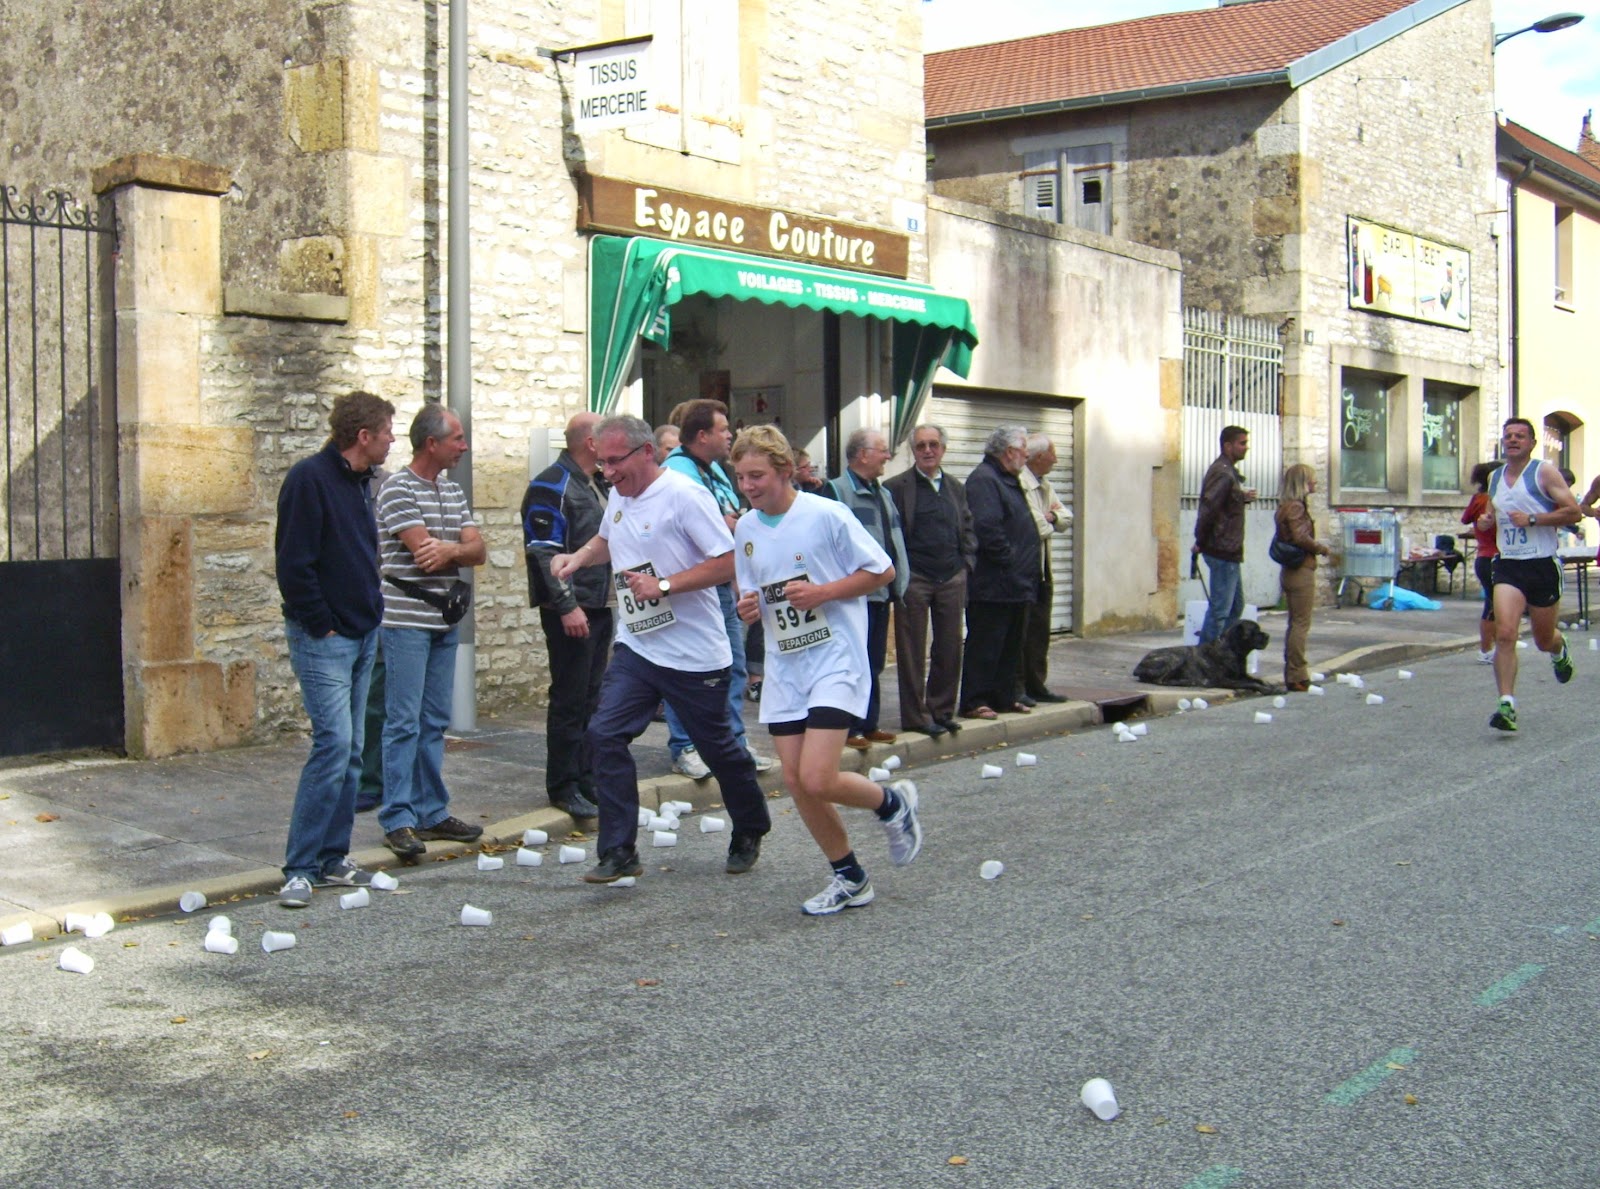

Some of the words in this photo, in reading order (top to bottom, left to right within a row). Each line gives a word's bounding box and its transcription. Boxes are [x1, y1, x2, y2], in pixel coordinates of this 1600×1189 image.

[589, 59, 637, 86] TISSUS
[580, 90, 647, 119] MERCERIE
[634, 188, 745, 240] Espace
[769, 212, 875, 265] Couture
[737, 270, 804, 296] VOILAGES
[813, 281, 859, 304] TISSUS
[867, 291, 927, 313] MERCERIE
[1503, 527, 1528, 545] 373
[775, 606, 817, 631] 592
[780, 628, 829, 650] D'EPARGNE
